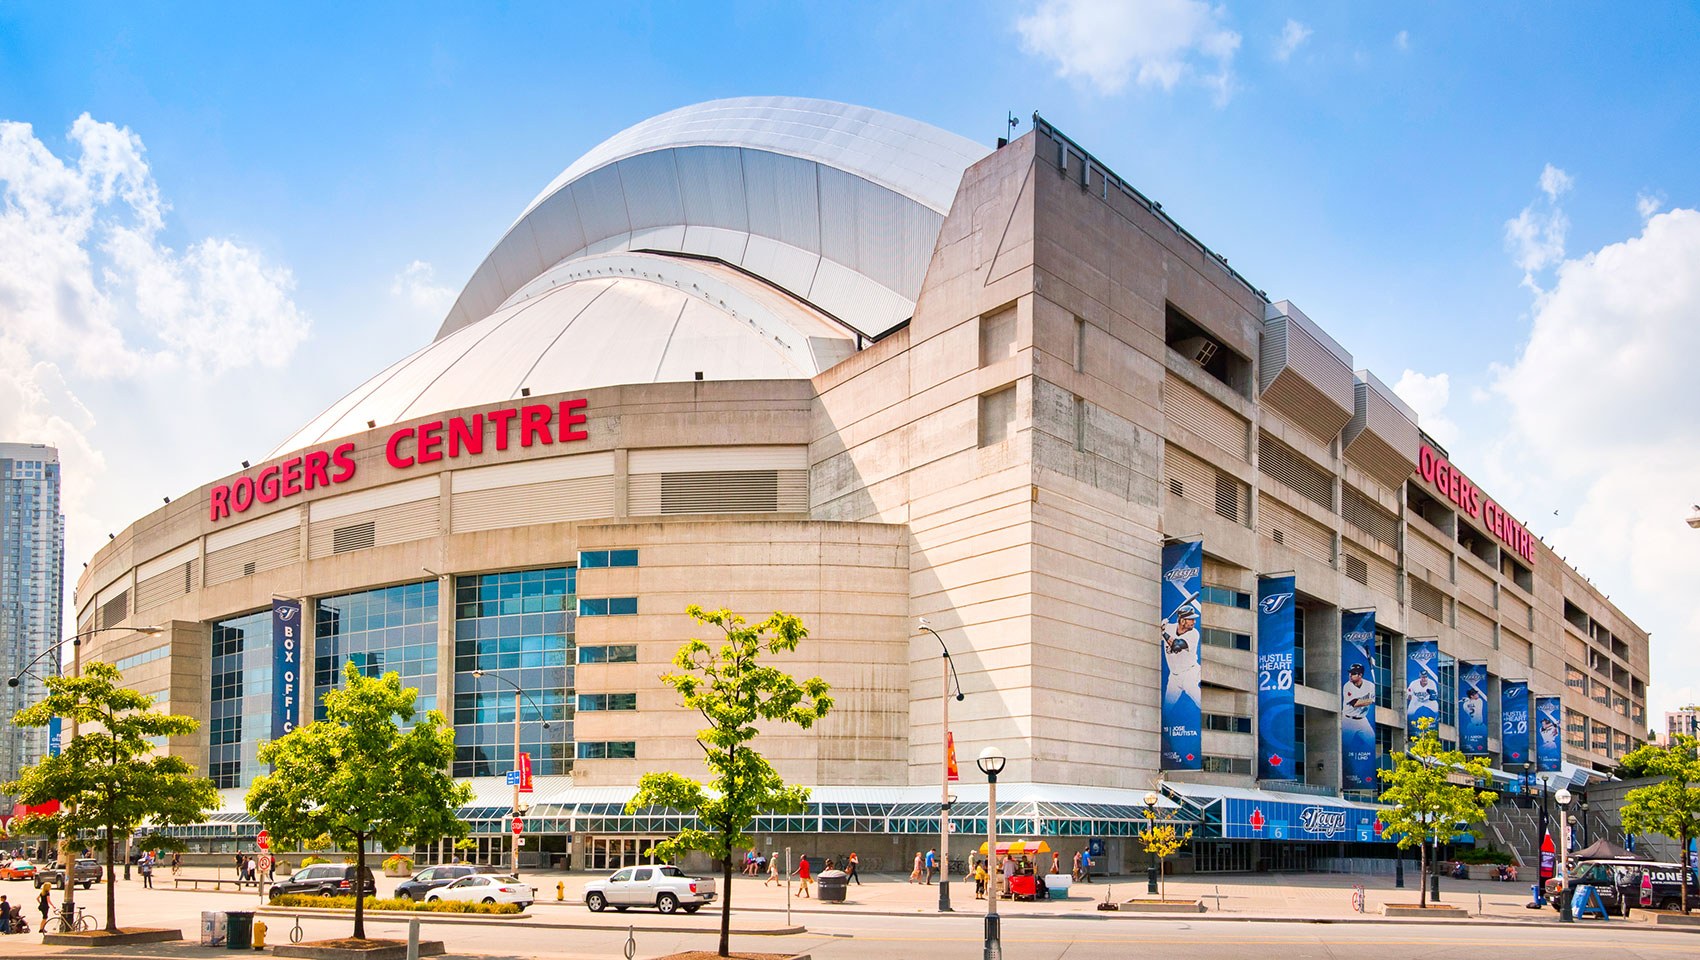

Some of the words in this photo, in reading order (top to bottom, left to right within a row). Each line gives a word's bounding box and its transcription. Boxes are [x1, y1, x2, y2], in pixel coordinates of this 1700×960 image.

[210, 443, 355, 521] ROGERS
[386, 399, 588, 469] CENTRE
[1415, 446, 1480, 519] OGERS
[1483, 499, 1536, 565] CENTRE
[284, 626, 294, 663] BOX
[1259, 653, 1293, 663] HUSTLE
[283, 671, 294, 734] OFFIC
[1274, 827, 1282, 838] 6
[1361, 831, 1368, 842] 5
